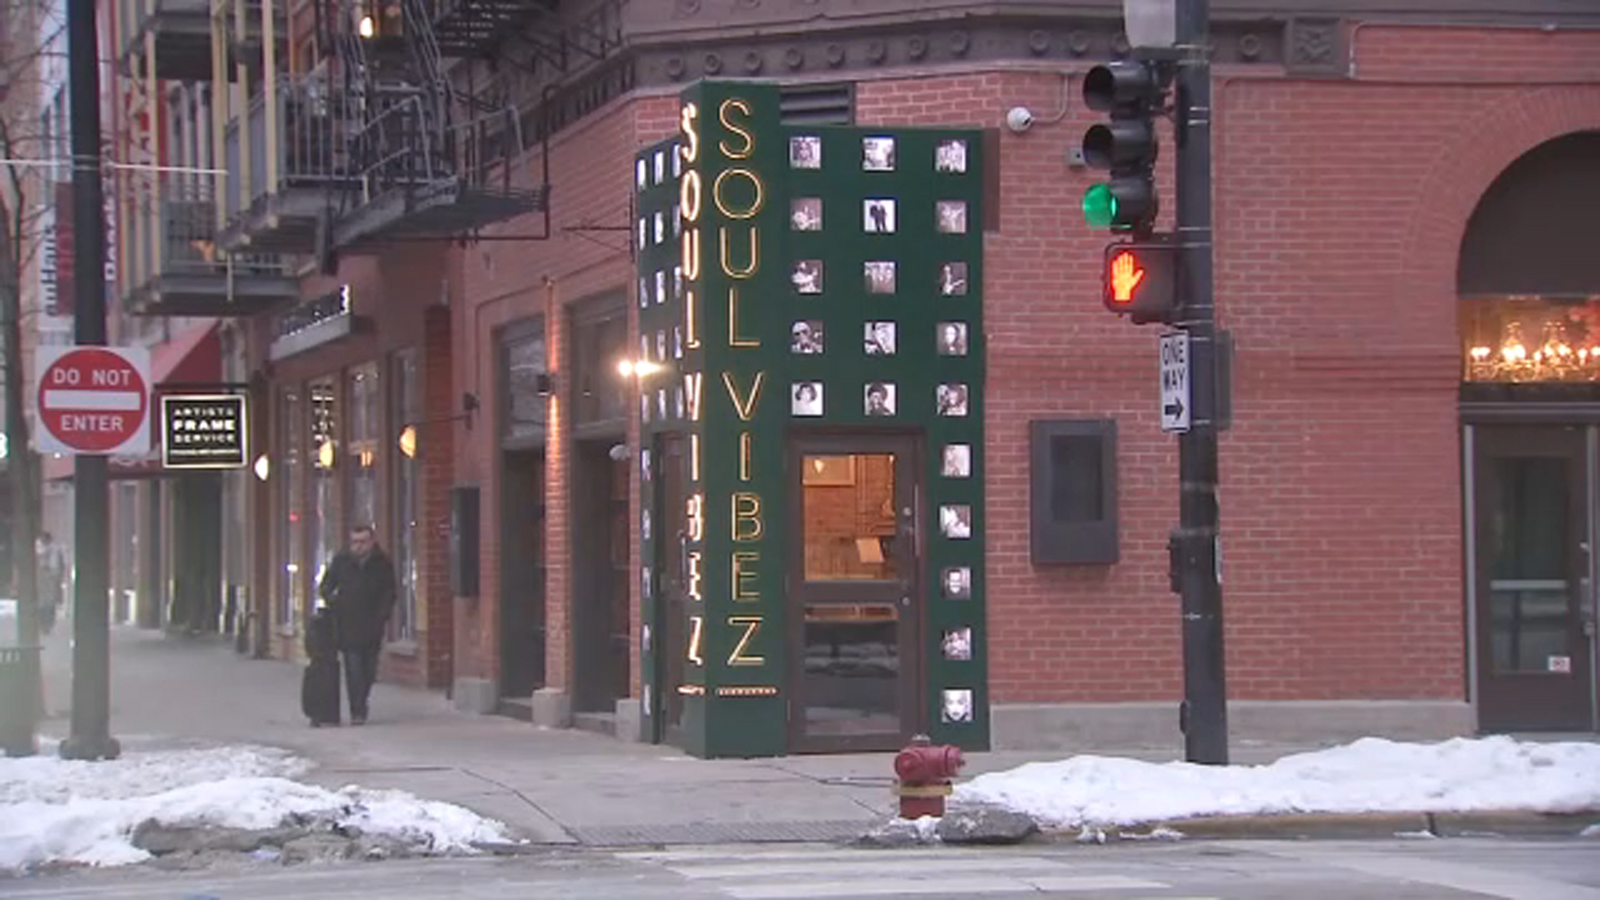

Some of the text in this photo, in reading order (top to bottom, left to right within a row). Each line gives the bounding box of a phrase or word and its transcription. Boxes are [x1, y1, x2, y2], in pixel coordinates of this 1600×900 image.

[680, 102, 701, 348] SOUL
[713, 98, 763, 347] SOUL
[1162, 338, 1185, 366] ONE
[53, 368, 131, 387] DO NOT
[1163, 367, 1186, 392] WAY
[60, 414, 125, 432] ENTER
[173, 419, 236, 432] FRAME
[174, 433, 236, 444] SERVICE
[683, 371, 704, 666] VIBEZ
[721, 371, 765, 666] VIBEZ
